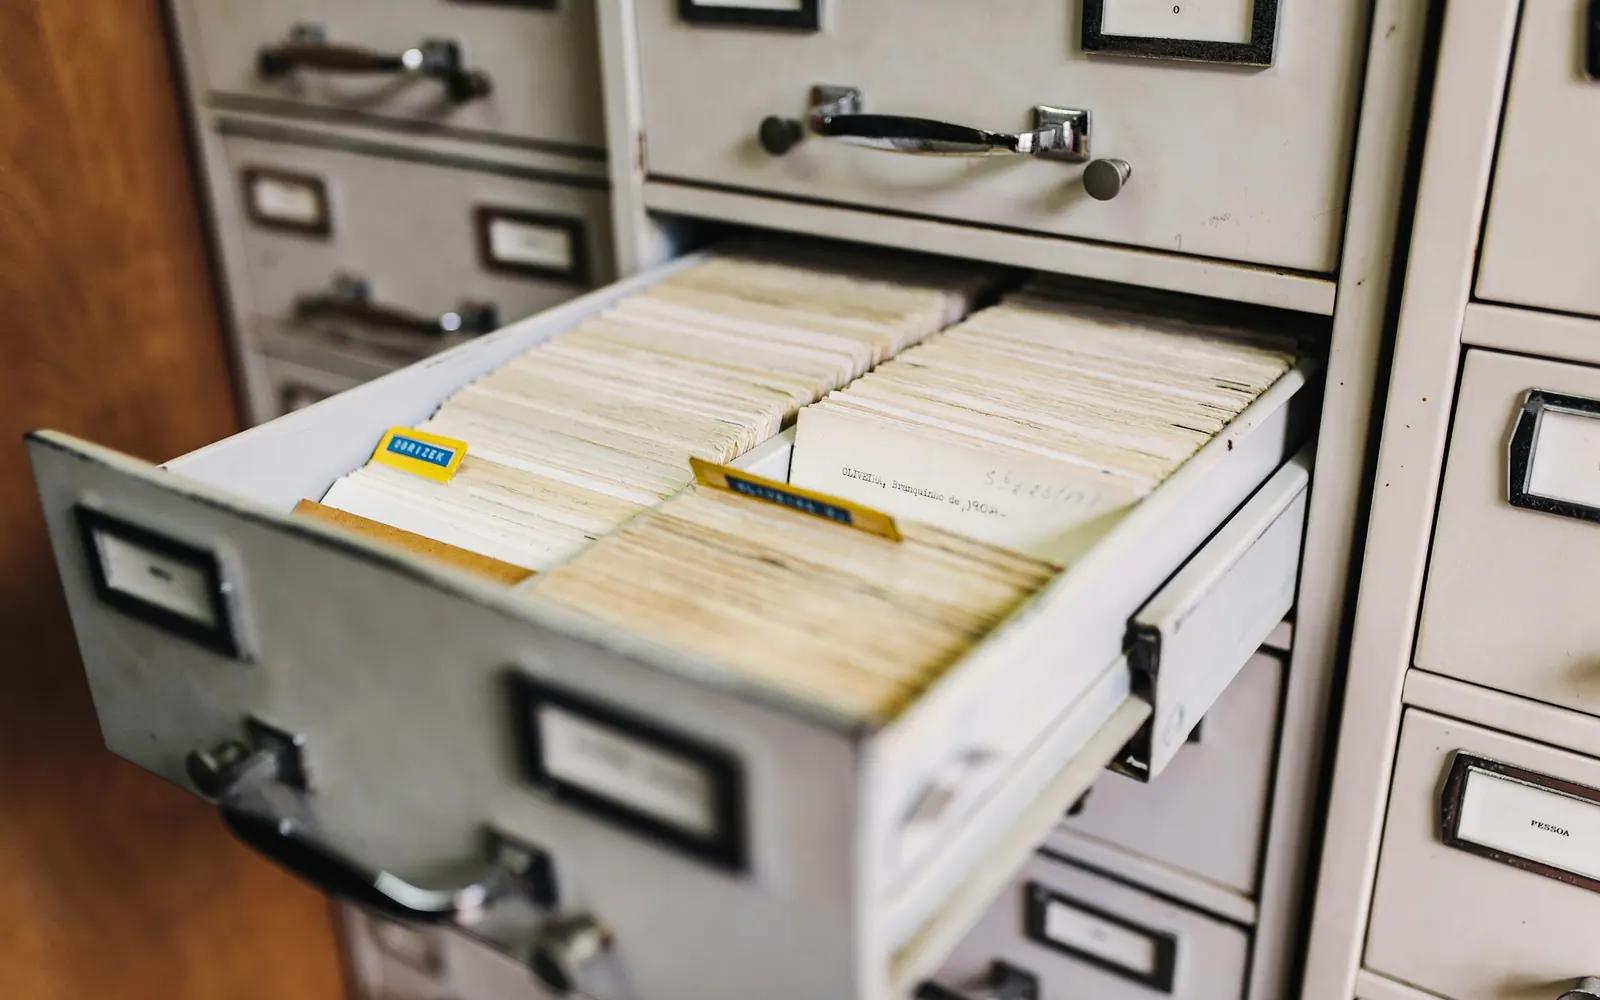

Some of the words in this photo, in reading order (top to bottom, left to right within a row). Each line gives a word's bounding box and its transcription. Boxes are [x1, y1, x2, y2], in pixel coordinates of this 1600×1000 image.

[841, 467, 886, 489] OLIVEIRA,
[891, 480, 944, 502] Branquinho
[1530, 819, 1570, 837] PESSOA
